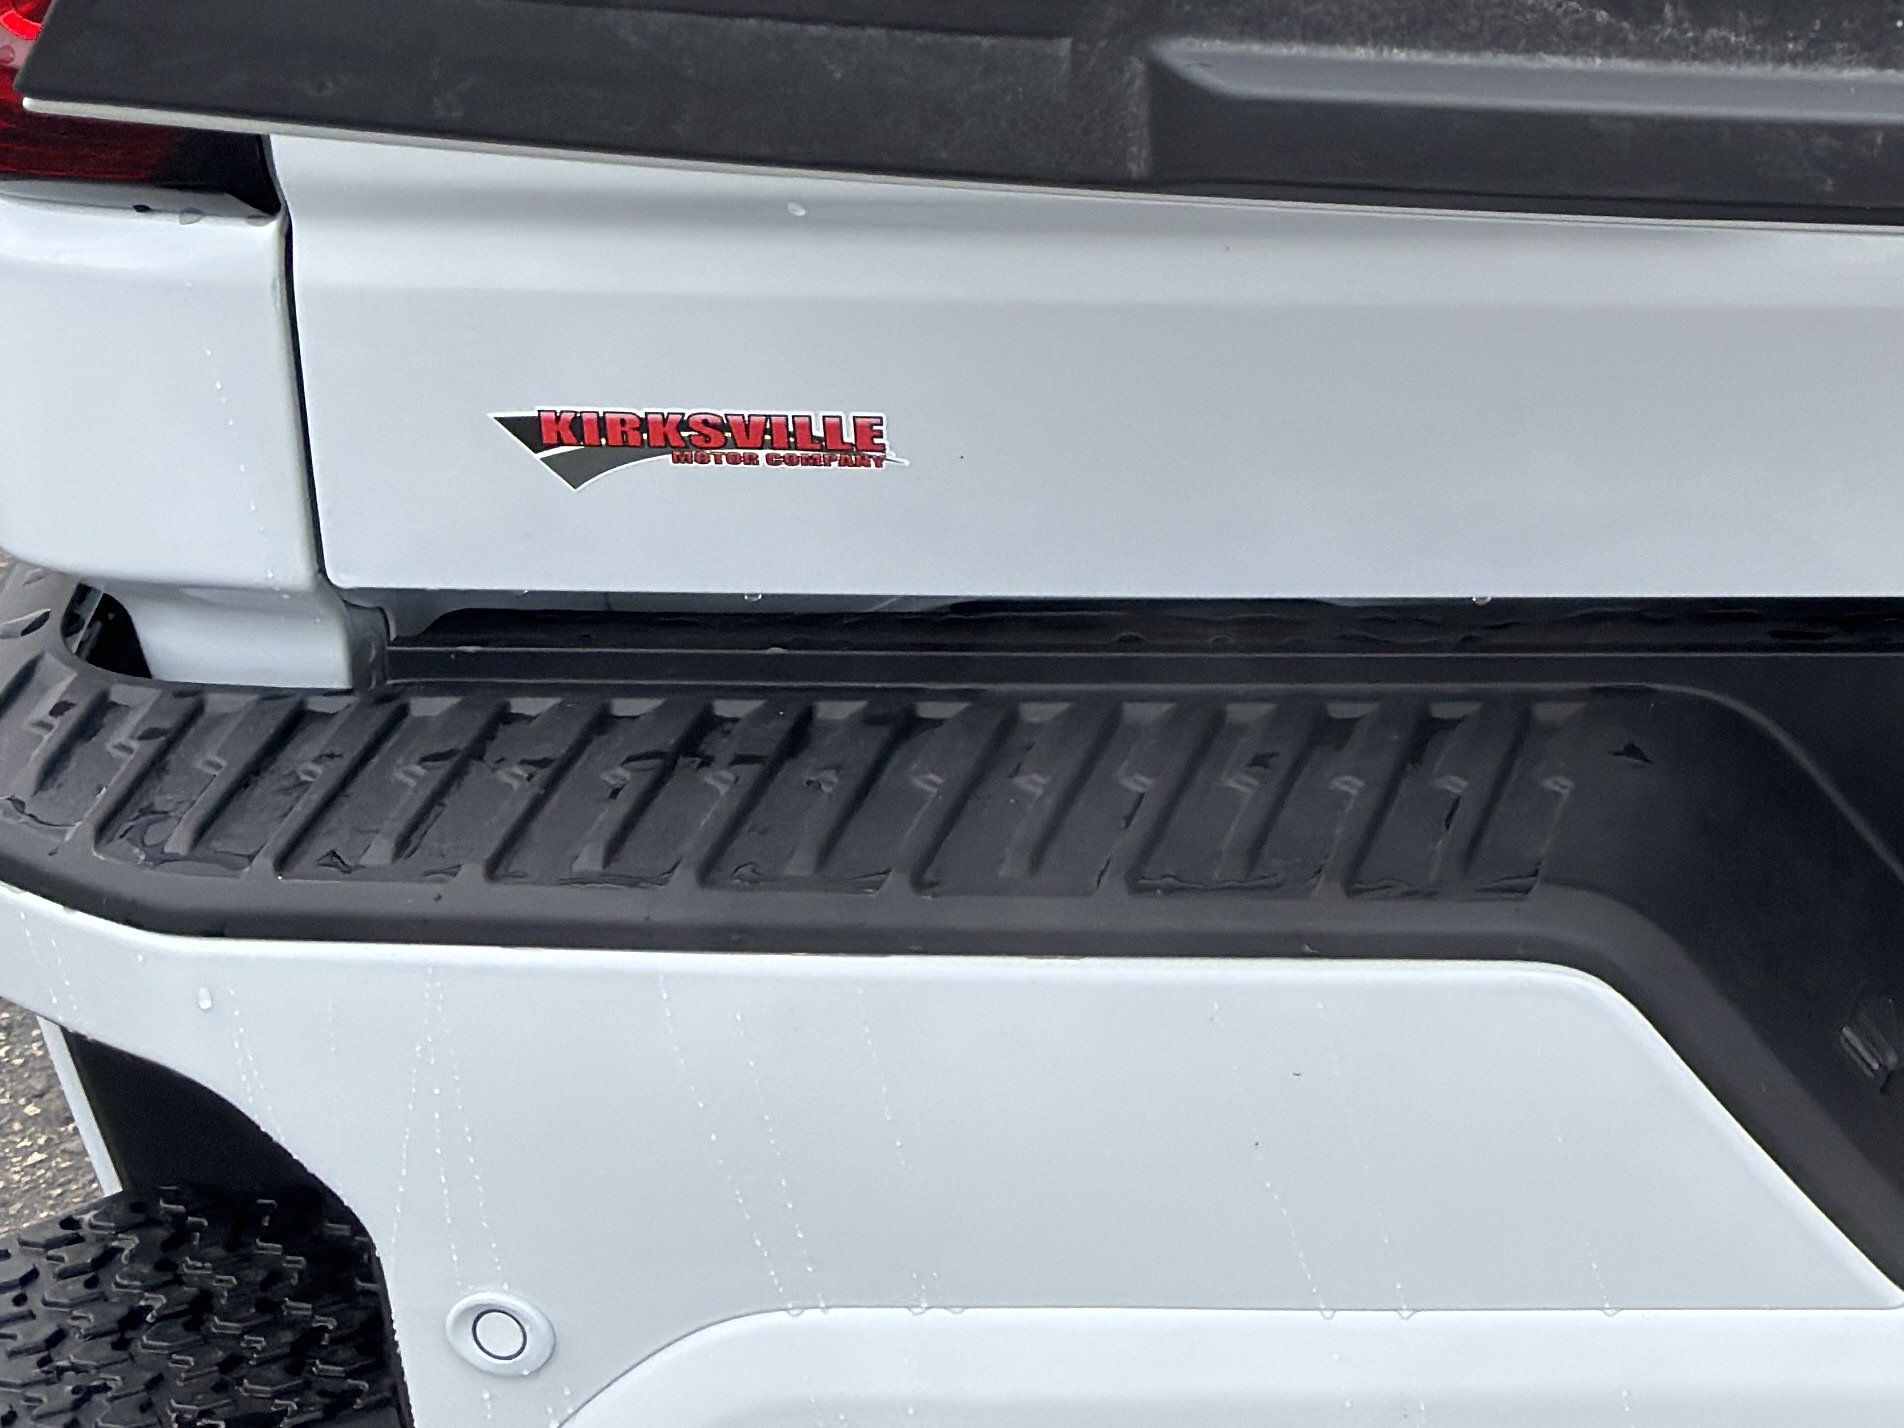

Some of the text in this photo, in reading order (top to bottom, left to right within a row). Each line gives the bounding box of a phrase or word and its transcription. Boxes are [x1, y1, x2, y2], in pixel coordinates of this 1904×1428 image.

[537, 409, 888, 453] KIRKSVILLE
[671, 450, 887, 469] MOTOR COMPANY
